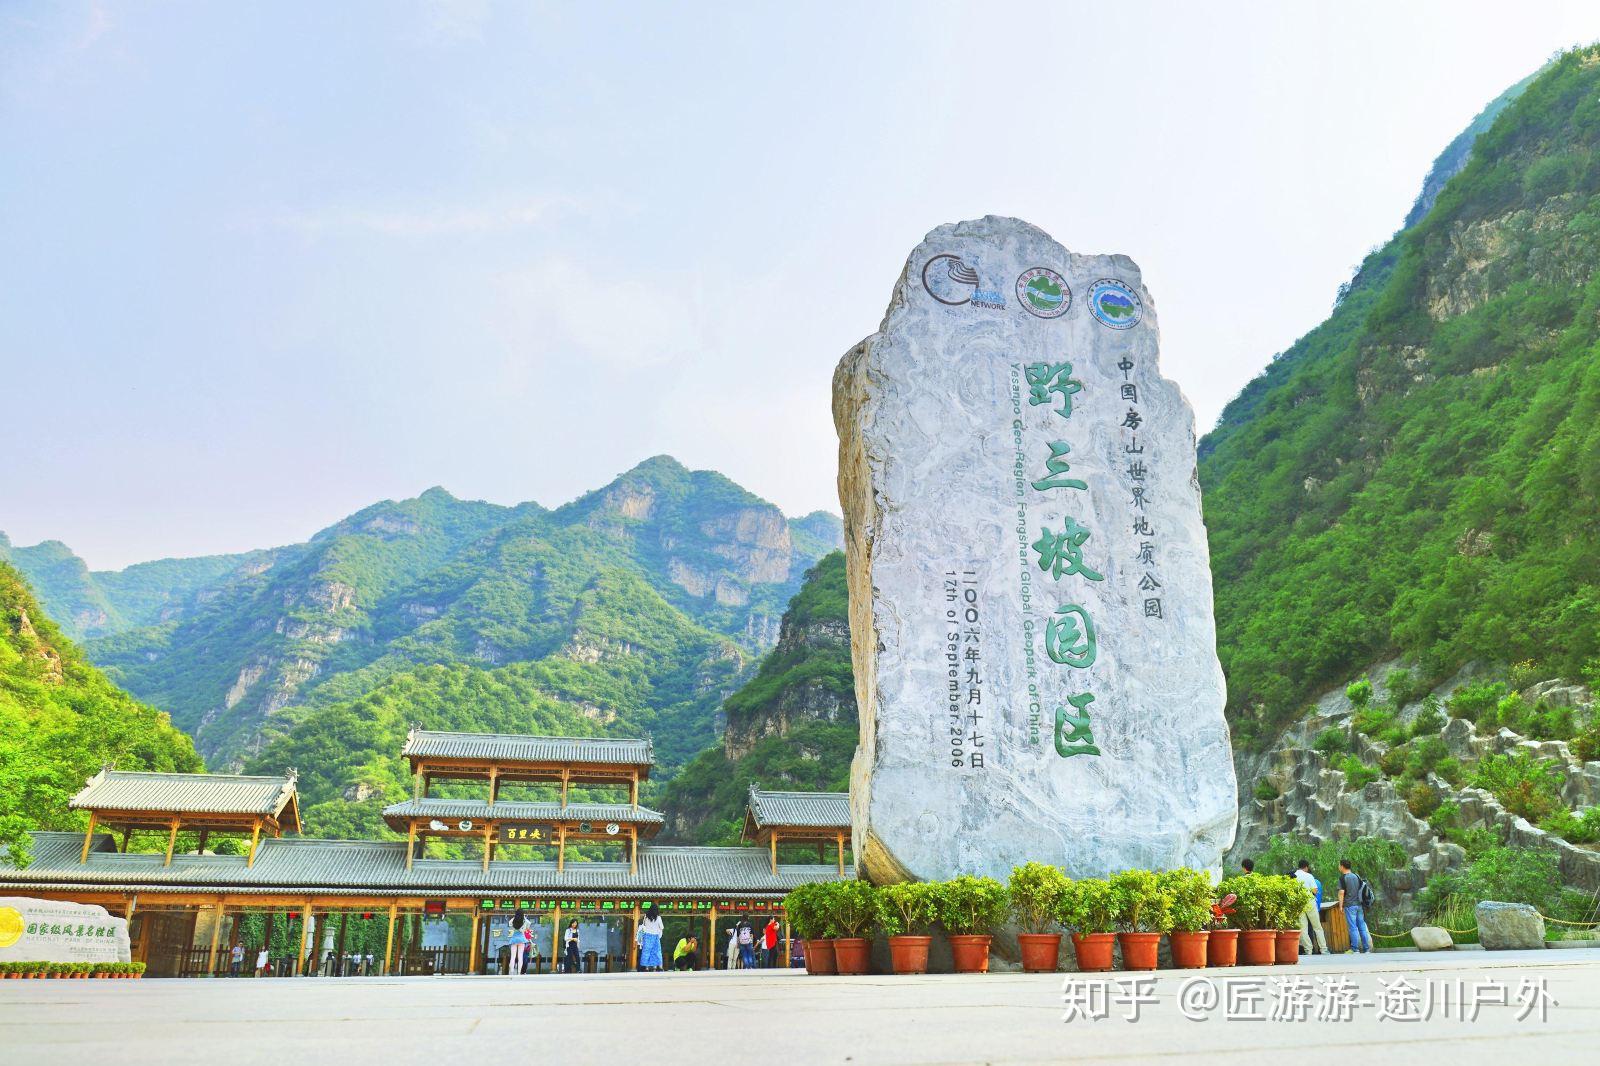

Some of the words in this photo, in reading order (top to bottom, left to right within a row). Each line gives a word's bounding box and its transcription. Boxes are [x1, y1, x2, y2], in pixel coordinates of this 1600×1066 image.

[971, 300, 1006, 311] NETWORK
[1011, 362, 1021, 415] Yesanpo
[1117, 356, 1163, 620] 中国房山世界地质公园
[1016, 502, 1029, 565] Fangshan
[1023, 361, 1104, 758] 野三坡园区
[945, 570, 958, 602] 17th
[1021, 571, 1033, 614] Global
[946, 609, 958, 625] of
[1023, 620, 1038, 678] Geopark
[1028, 683, 1040, 697] of
[1029, 702, 1041, 745] China
[26, 922, 116, 938] 国家级风景名胜区
